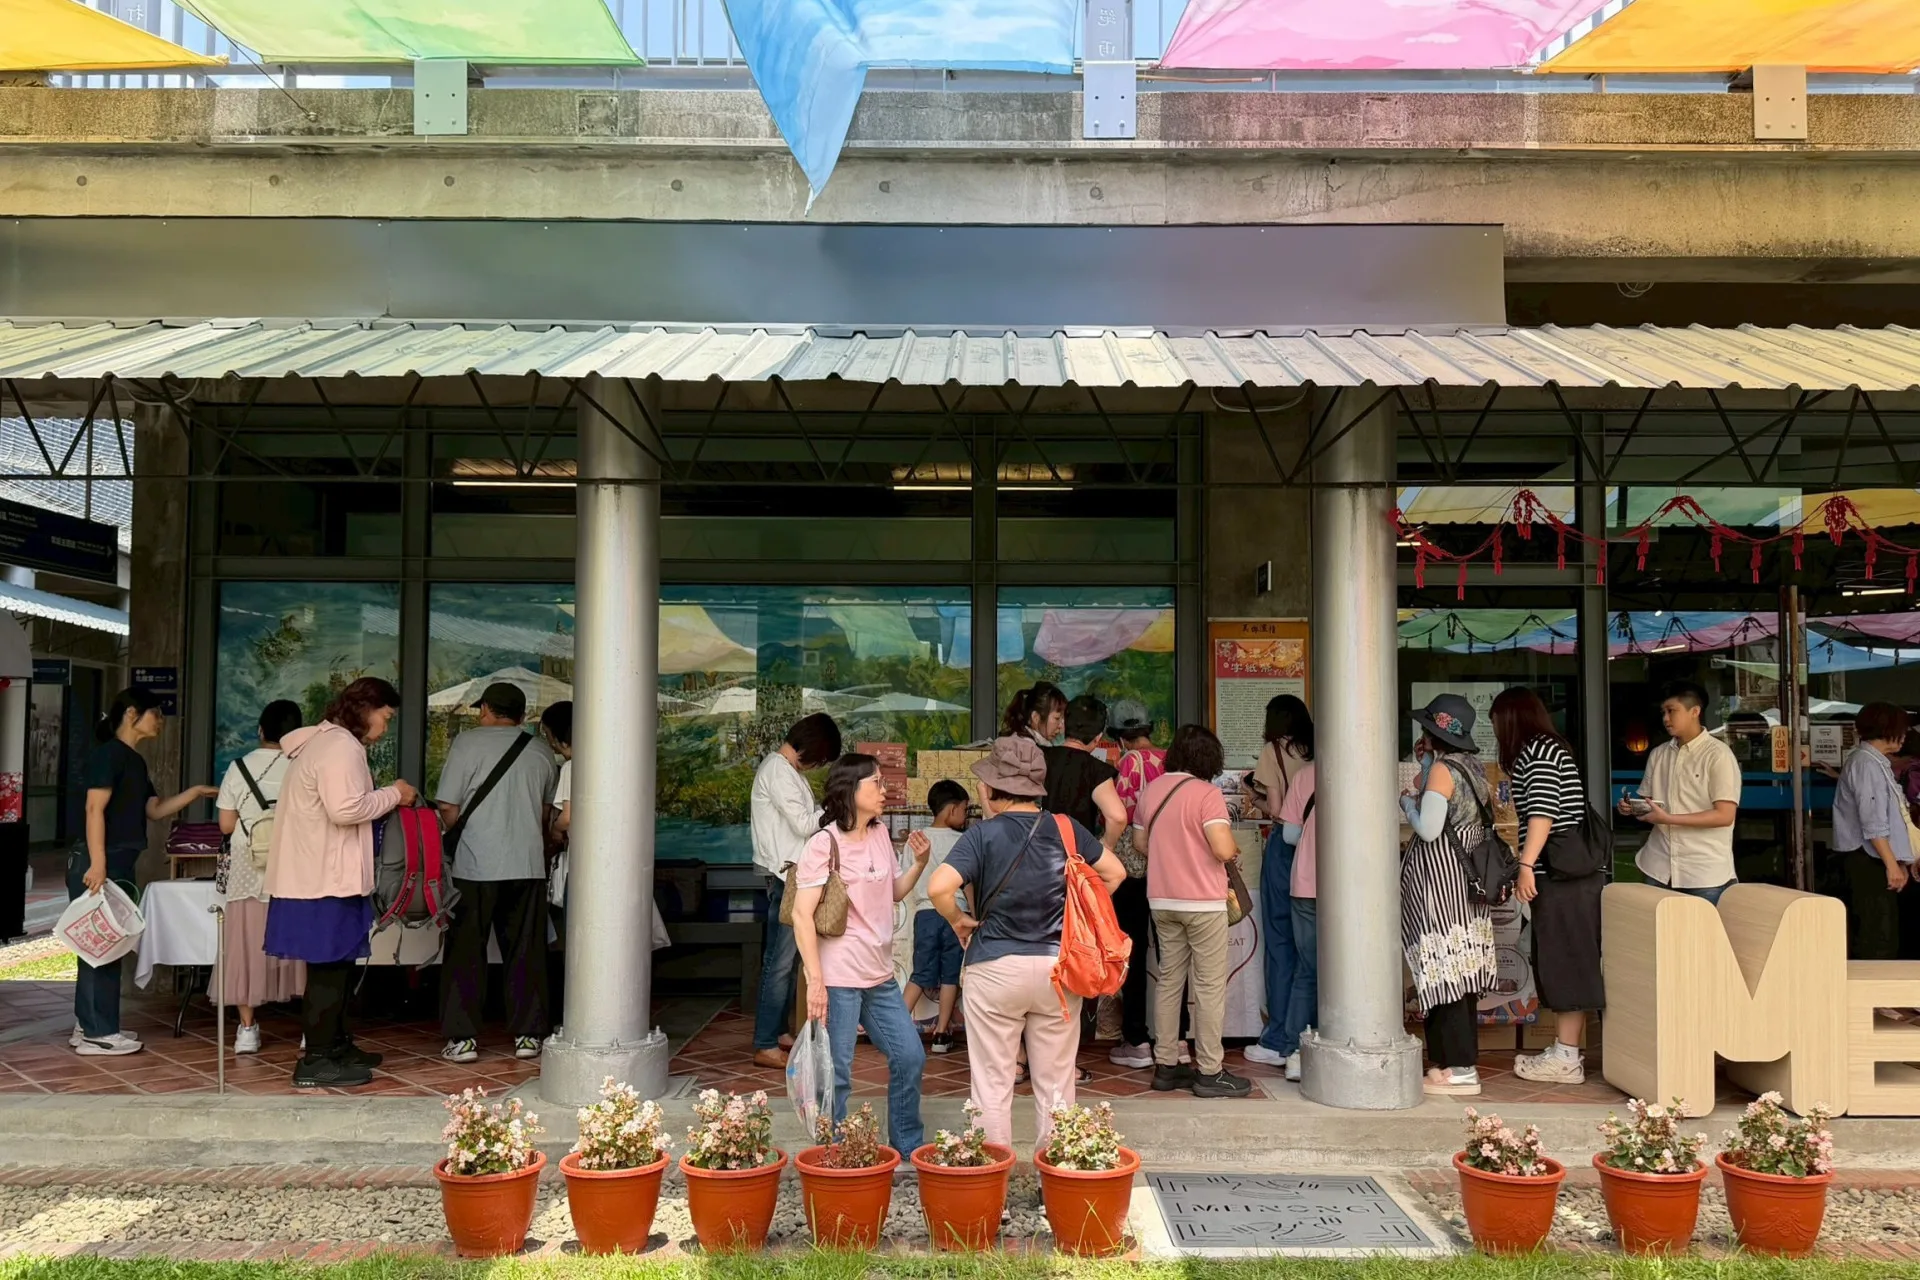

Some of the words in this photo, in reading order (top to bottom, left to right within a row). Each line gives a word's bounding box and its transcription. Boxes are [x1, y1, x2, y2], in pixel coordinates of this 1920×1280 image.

[1775, 729, 1786, 769] 小心玻璃
[1191, 1203, 1371, 1213] MEINONG
